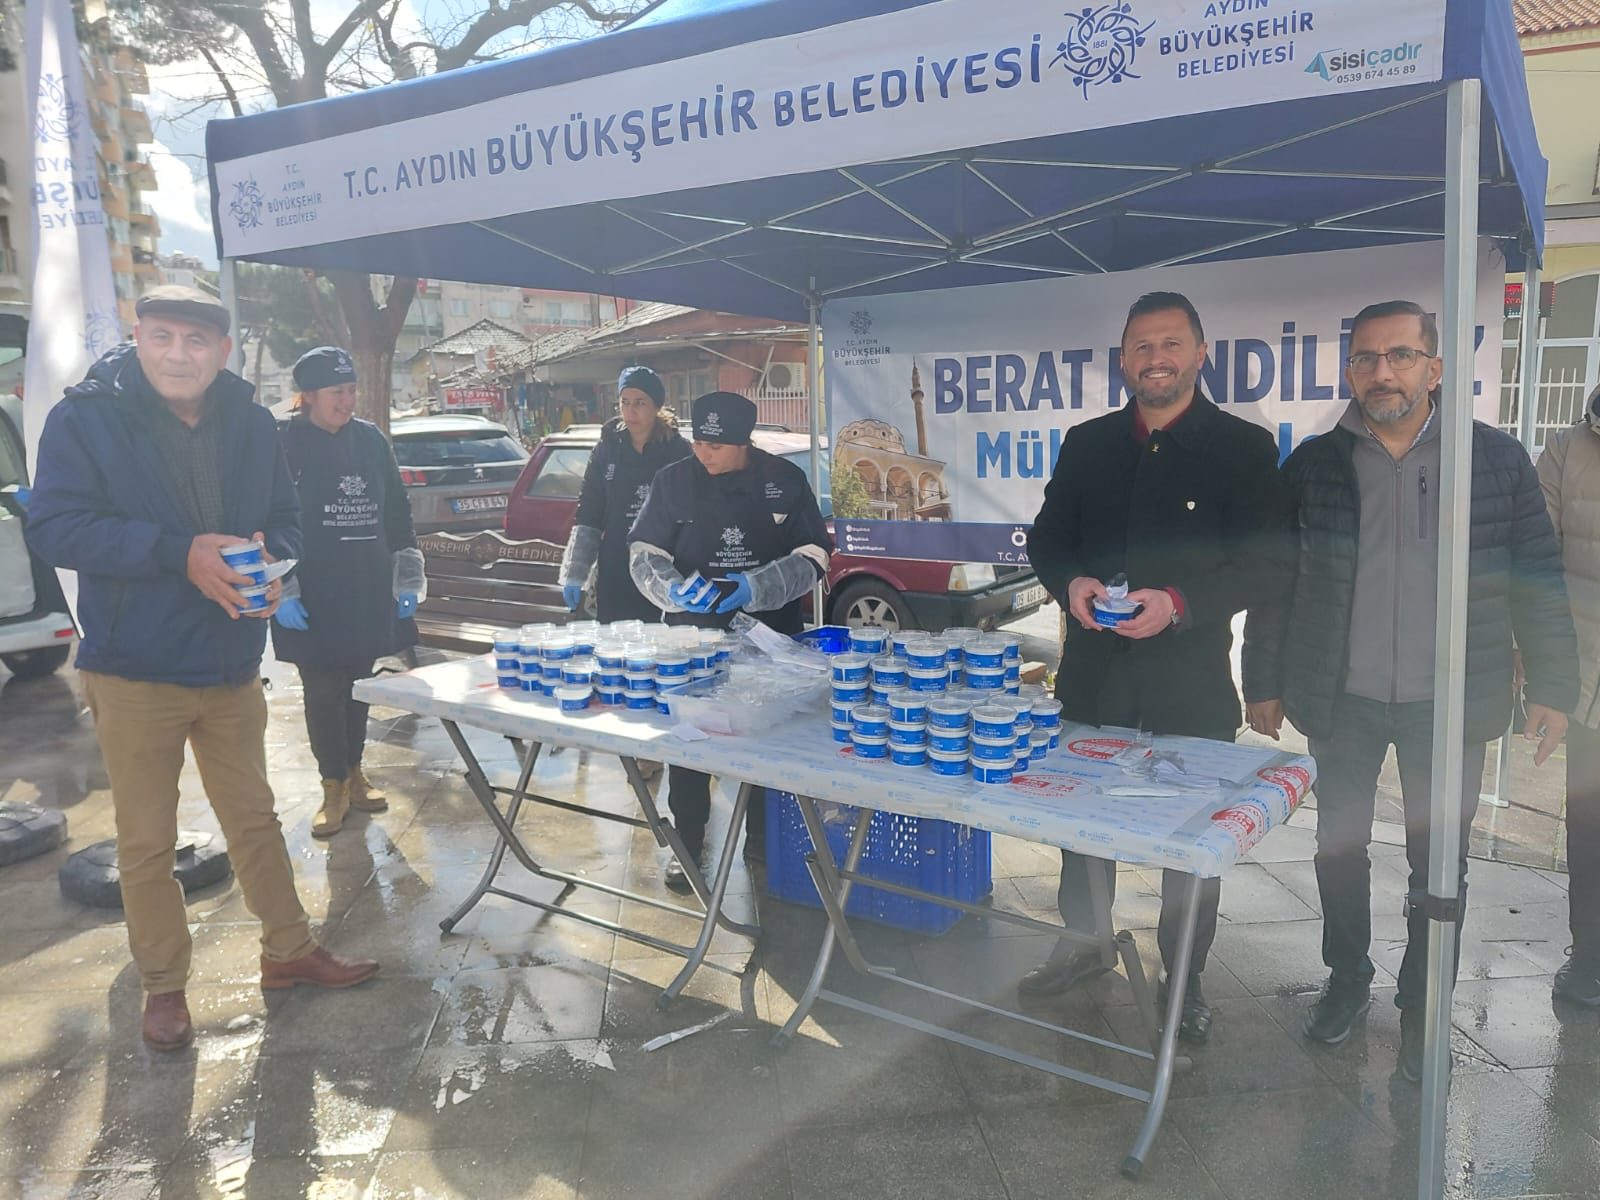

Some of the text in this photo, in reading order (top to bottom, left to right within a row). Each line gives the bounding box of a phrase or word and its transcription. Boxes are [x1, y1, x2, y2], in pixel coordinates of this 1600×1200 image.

[1159, 11, 1314, 55] BÜYÜKŞEHİR
[1178, 41, 1294, 78] BELEDİYESİ
[1329, 42, 1422, 71] sisiçadır
[1337, 64, 1416, 83] 0539 674 45 89
[344, 34, 1042, 199] T.C. AYDIN BÜYÜKŞEHİR BELEDİYESİ
[267, 192, 322, 213] BÜYÜKŞEHİR
[276, 211, 318, 227] BELEDİYESİ
[834, 345, 891, 358] BÜYÜKŞEHİR
[934, 348, 1093, 415] BERAT
